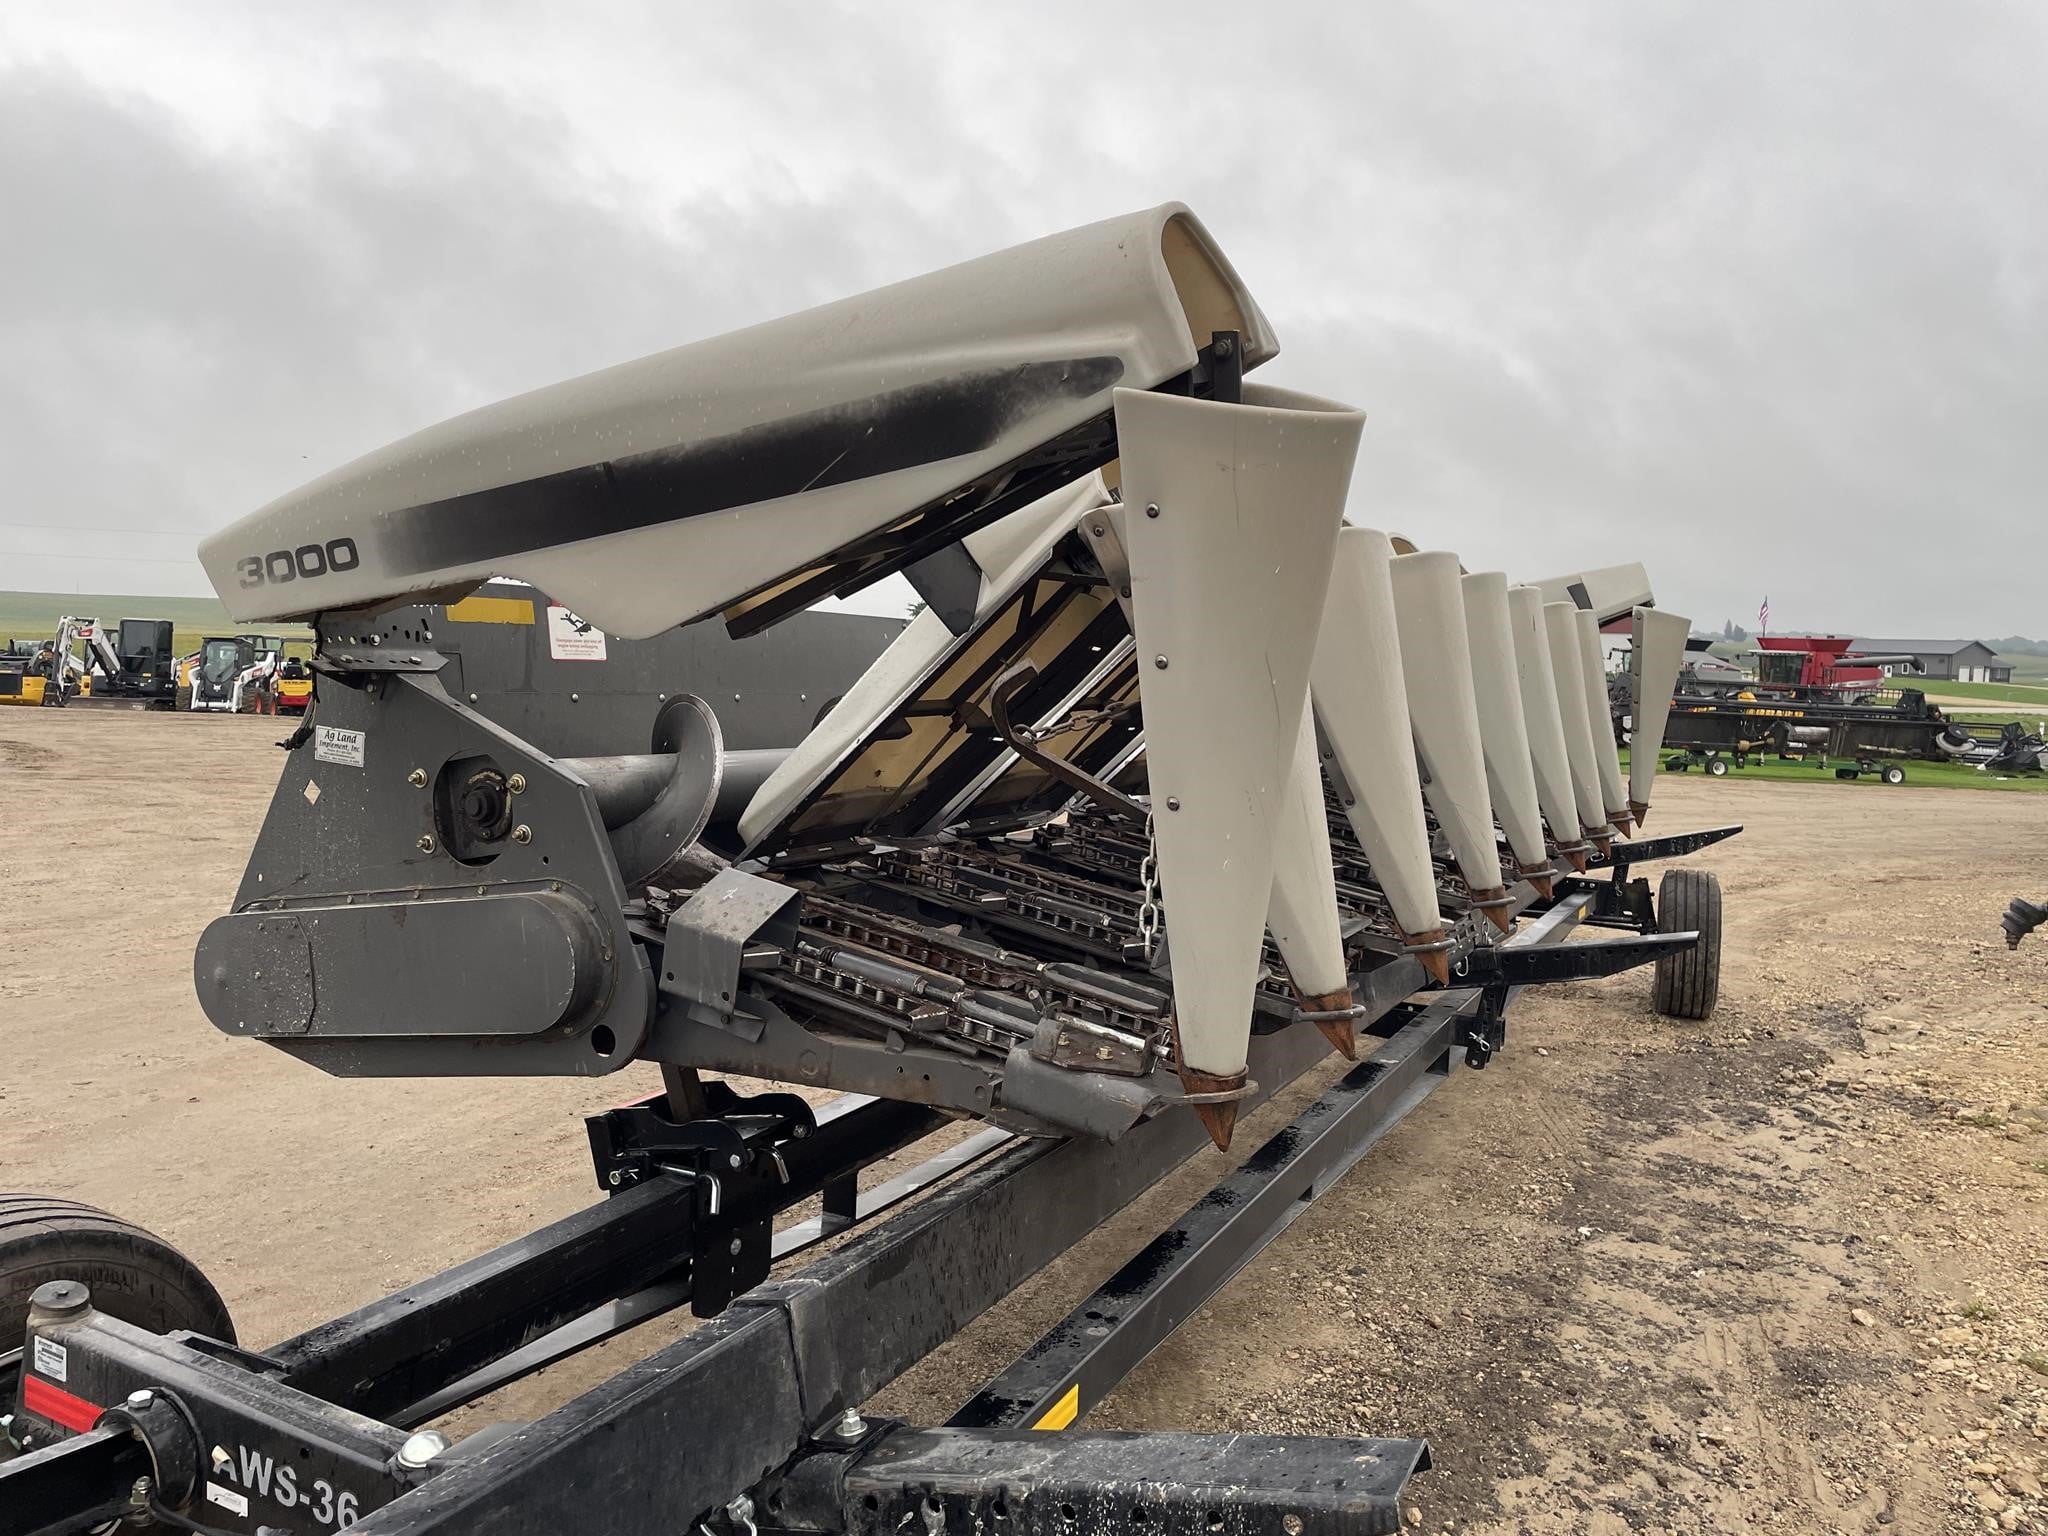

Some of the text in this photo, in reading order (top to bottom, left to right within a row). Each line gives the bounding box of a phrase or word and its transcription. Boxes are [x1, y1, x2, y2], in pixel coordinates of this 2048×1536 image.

[237, 537, 359, 589] 3000
[324, 730, 357, 744] Ag Land
